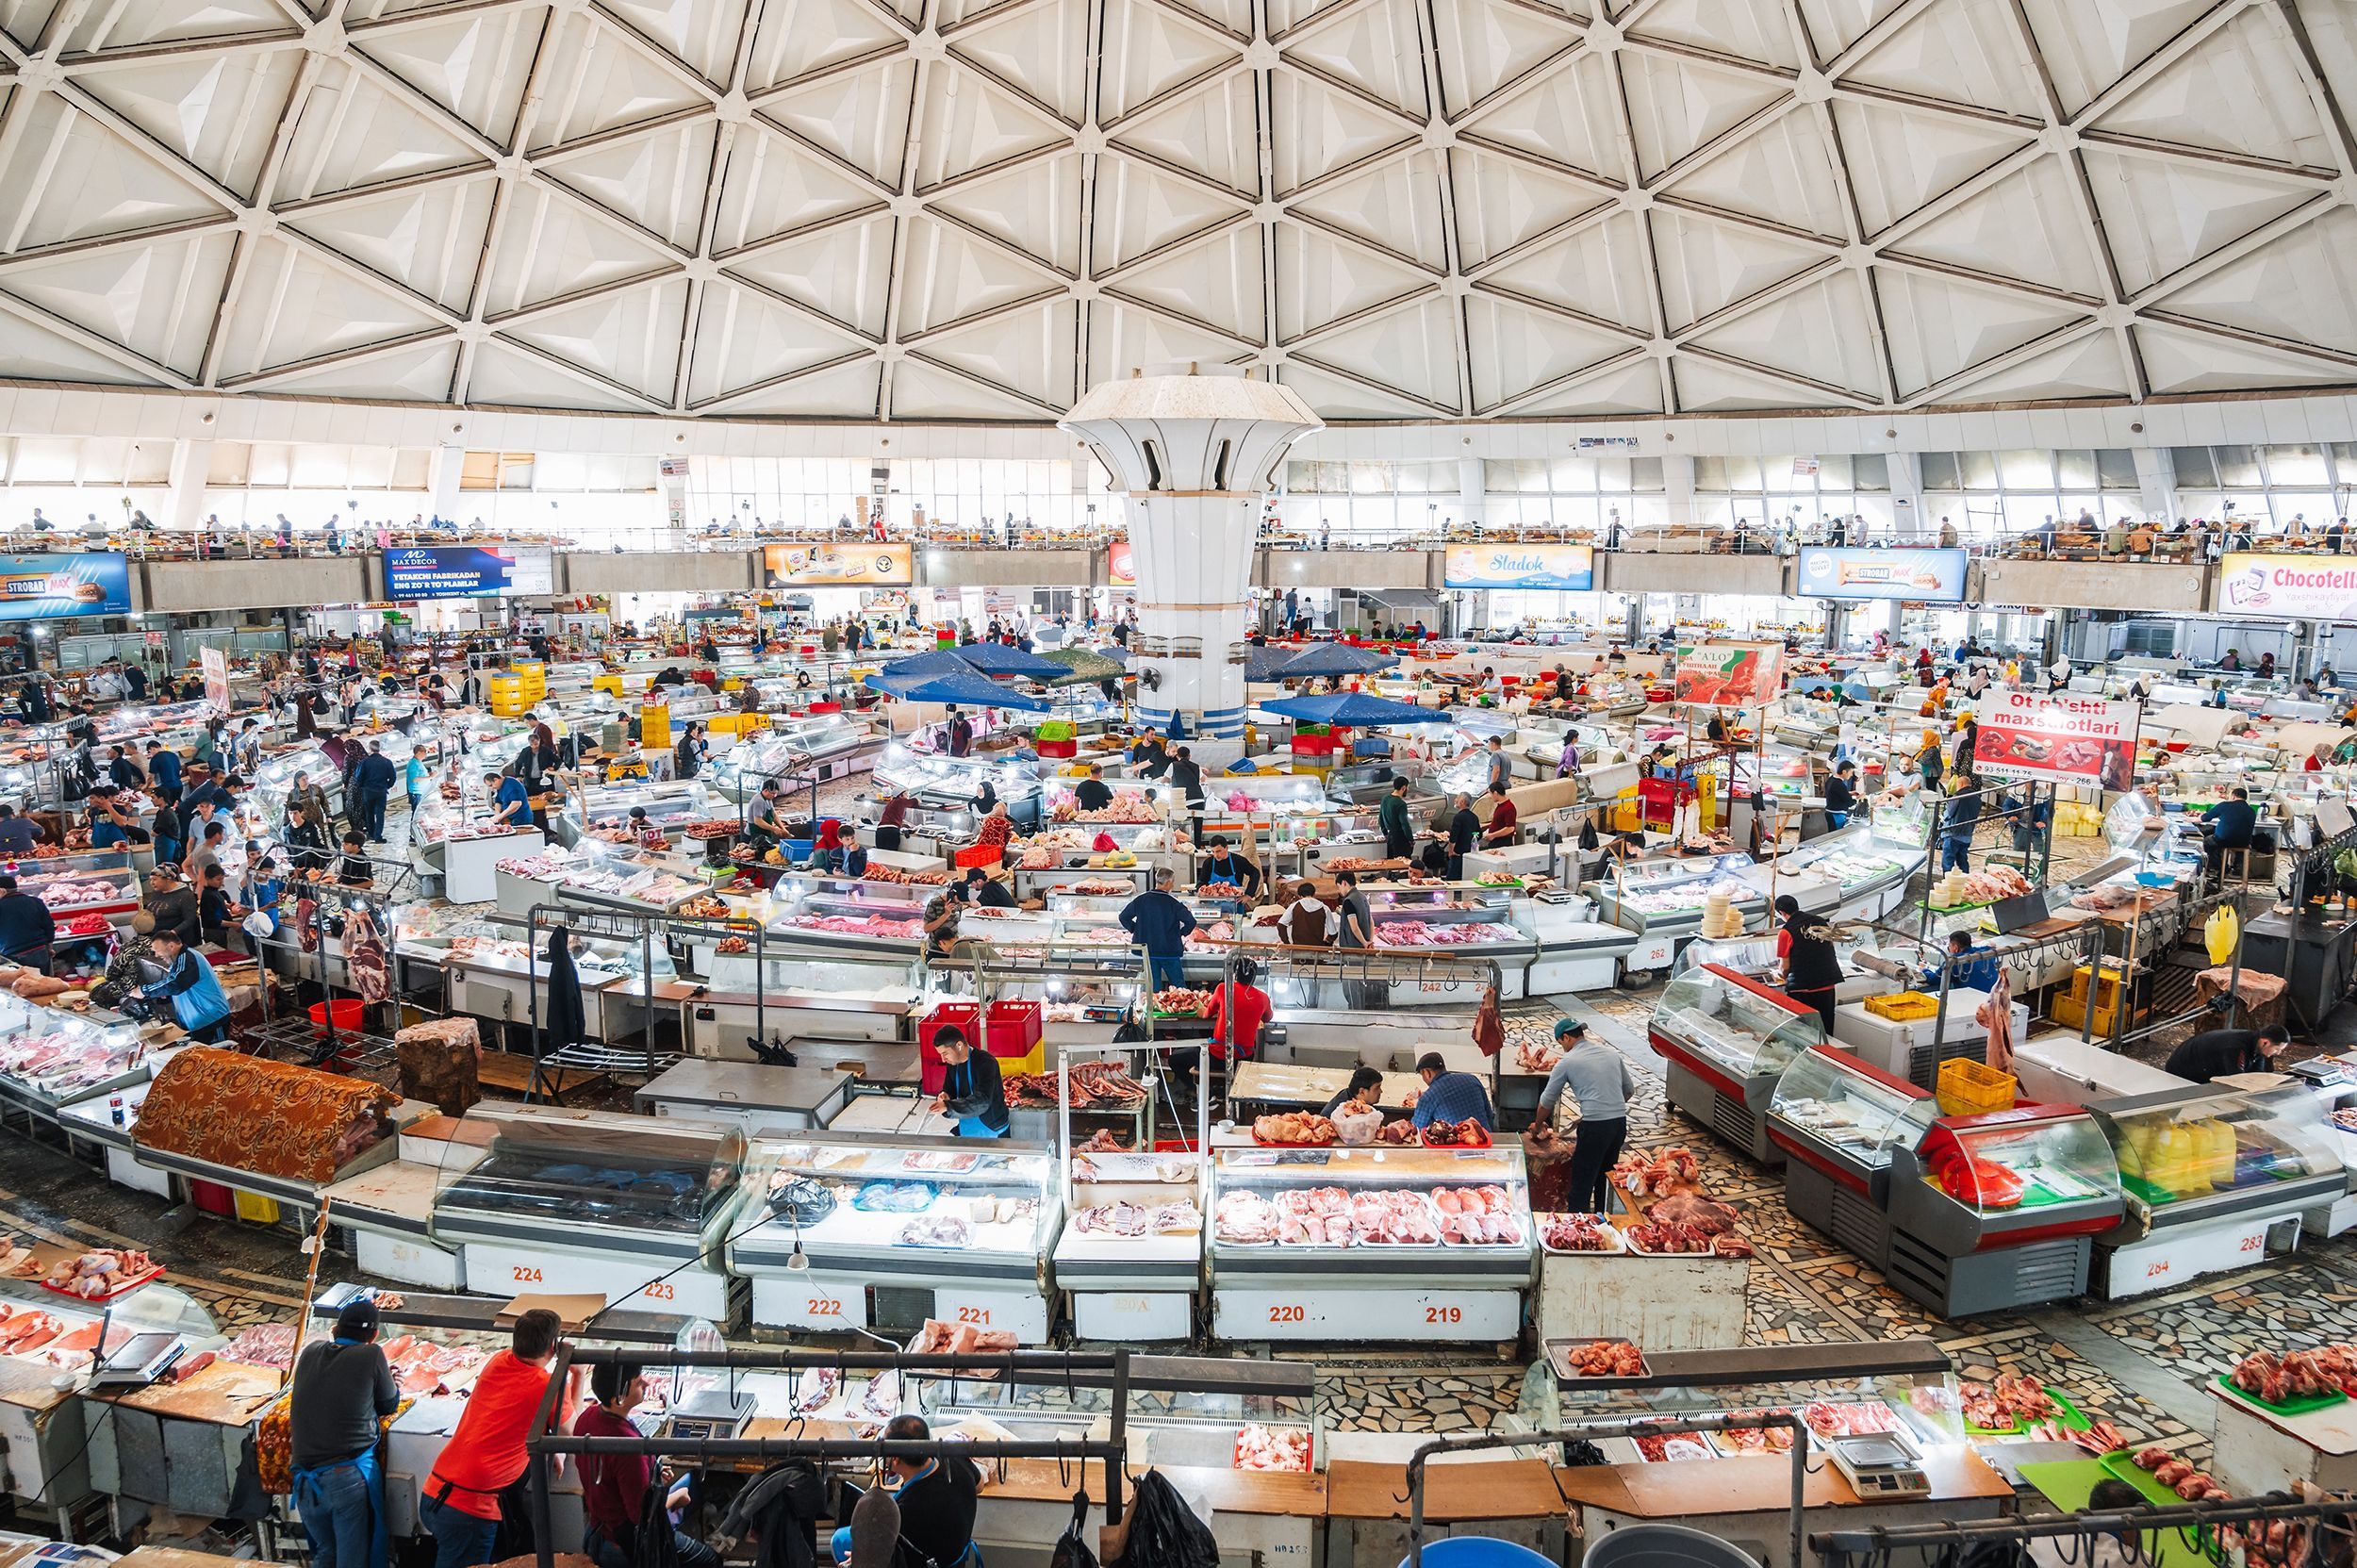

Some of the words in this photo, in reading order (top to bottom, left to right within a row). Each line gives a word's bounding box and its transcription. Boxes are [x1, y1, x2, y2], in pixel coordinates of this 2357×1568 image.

[1490, 553, 1544, 571] Sladok
[433, 571, 481, 580] FABRIKADAN
[1859, 568, 1889, 579] STROBAR
[1892, 568, 1911, 578] MAX
[2273, 569, 2357, 589] Chocotell
[8, 580, 45, 593] STROBAR
[50, 576, 71, 591] MAX
[2010, 694, 2034, 708] Ot
[2076, 777, 2091, 785] 266
[1422, 982, 1442, 992] 242
[2240, 1234, 2263, 1251] 283
[513, 1266, 543, 1283] 224
[2147, 1260, 2169, 1277] 284
[643, 1281, 674, 1300] 223
[807, 1298, 842, 1315] 222
[1269, 1305, 1305, 1322] 220
[1426, 1307, 1461, 1323] 219
[958, 1306, 991, 1325] 221
